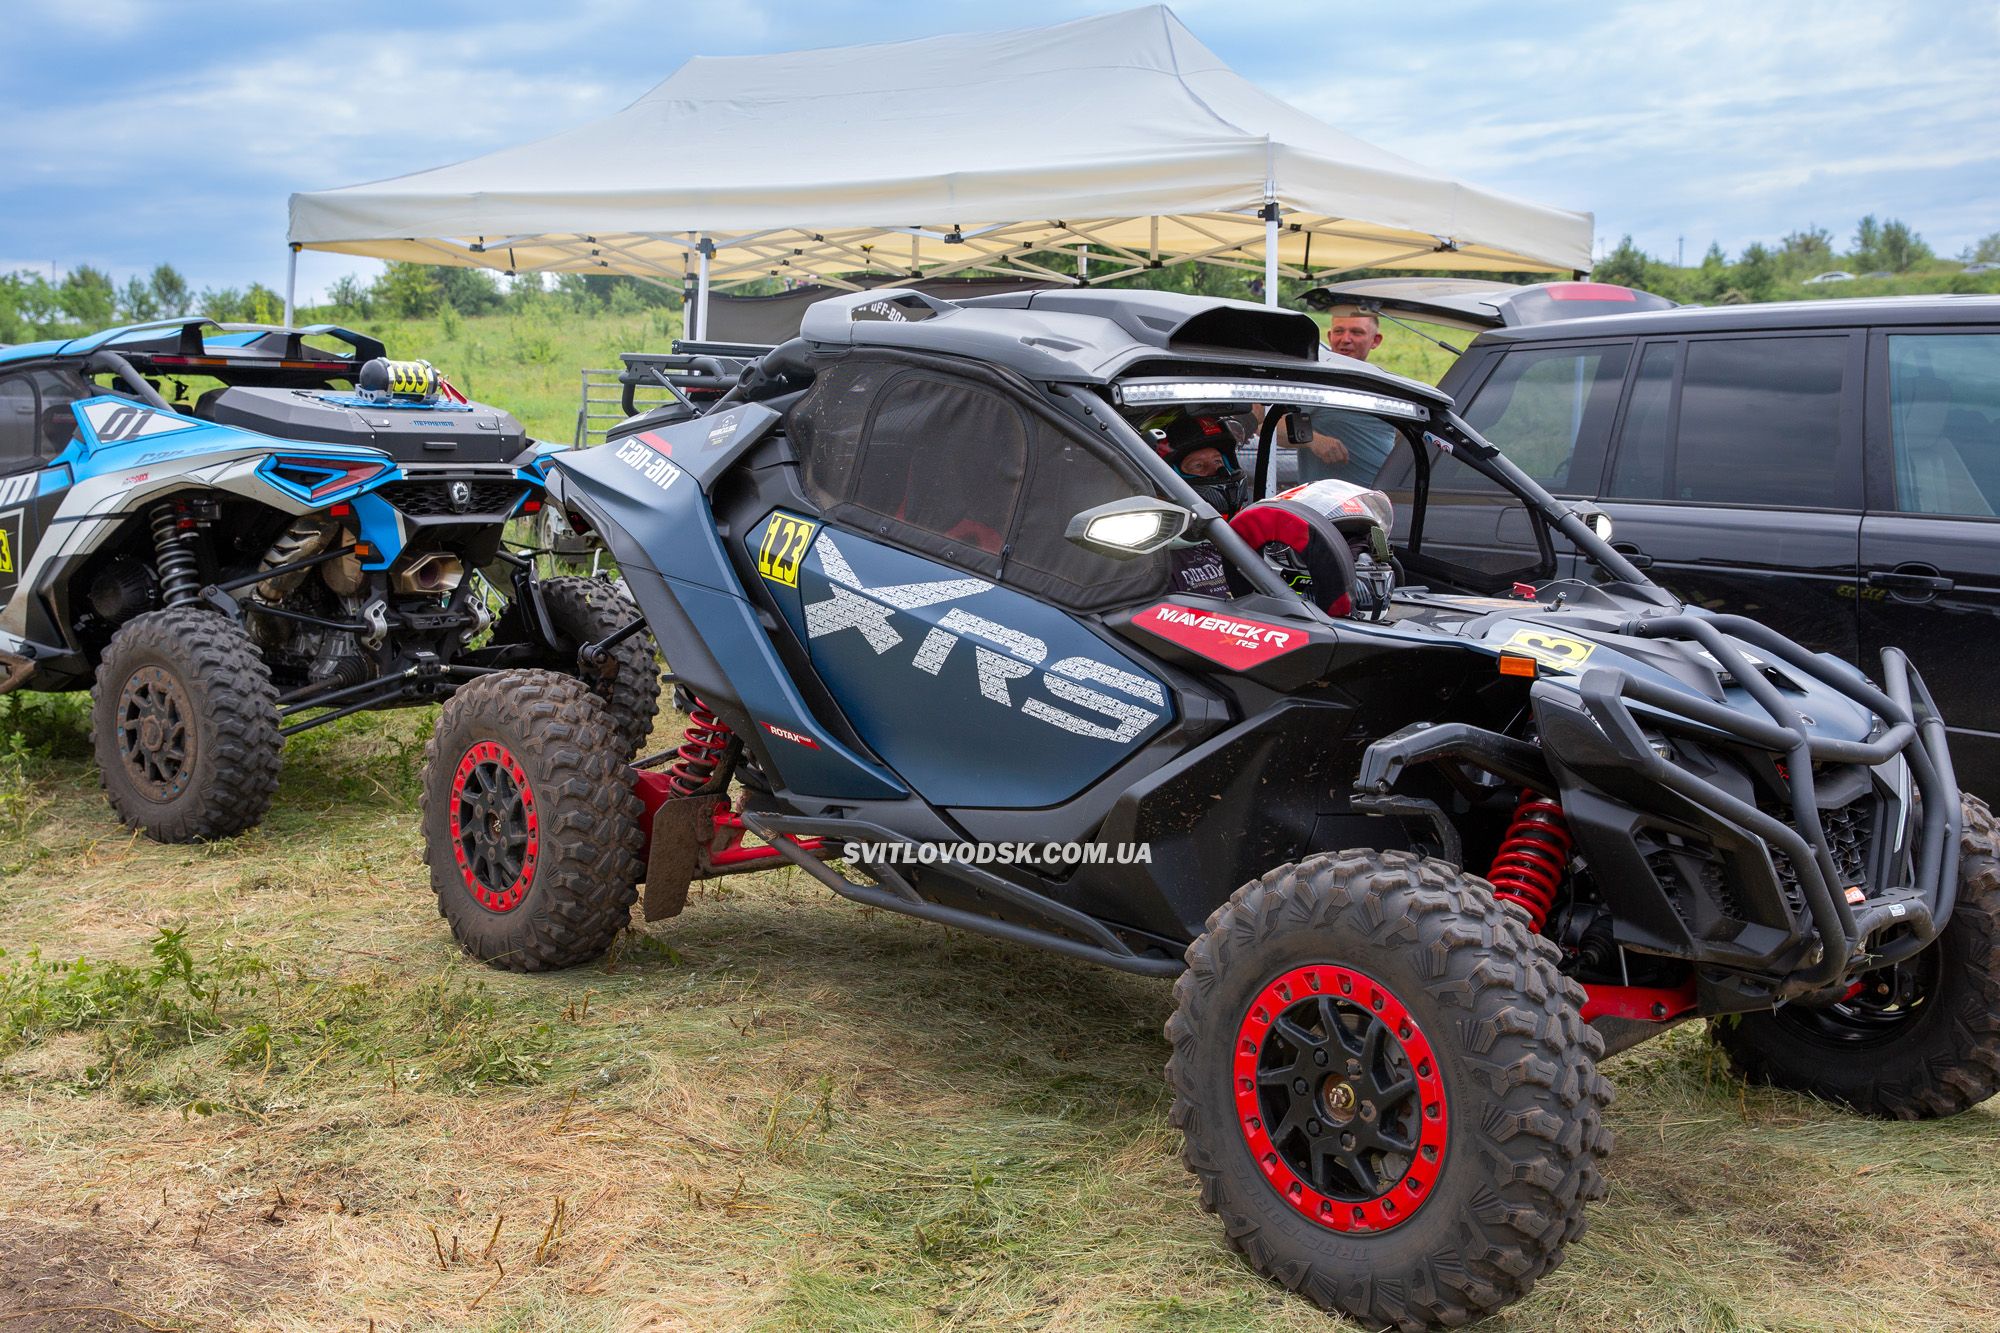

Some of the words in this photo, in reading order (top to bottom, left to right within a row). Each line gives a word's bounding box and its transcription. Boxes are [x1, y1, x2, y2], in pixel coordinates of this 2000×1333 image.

[98, 406, 155, 441] 01
[615, 438, 680, 490] can-am
[760, 517, 810, 583] 123
[804, 531, 1165, 744] XRS
[1156, 607, 1266, 641] MAVERICK
[1263, 630, 1290, 648] R
[770, 725, 801, 743] ROTAX
